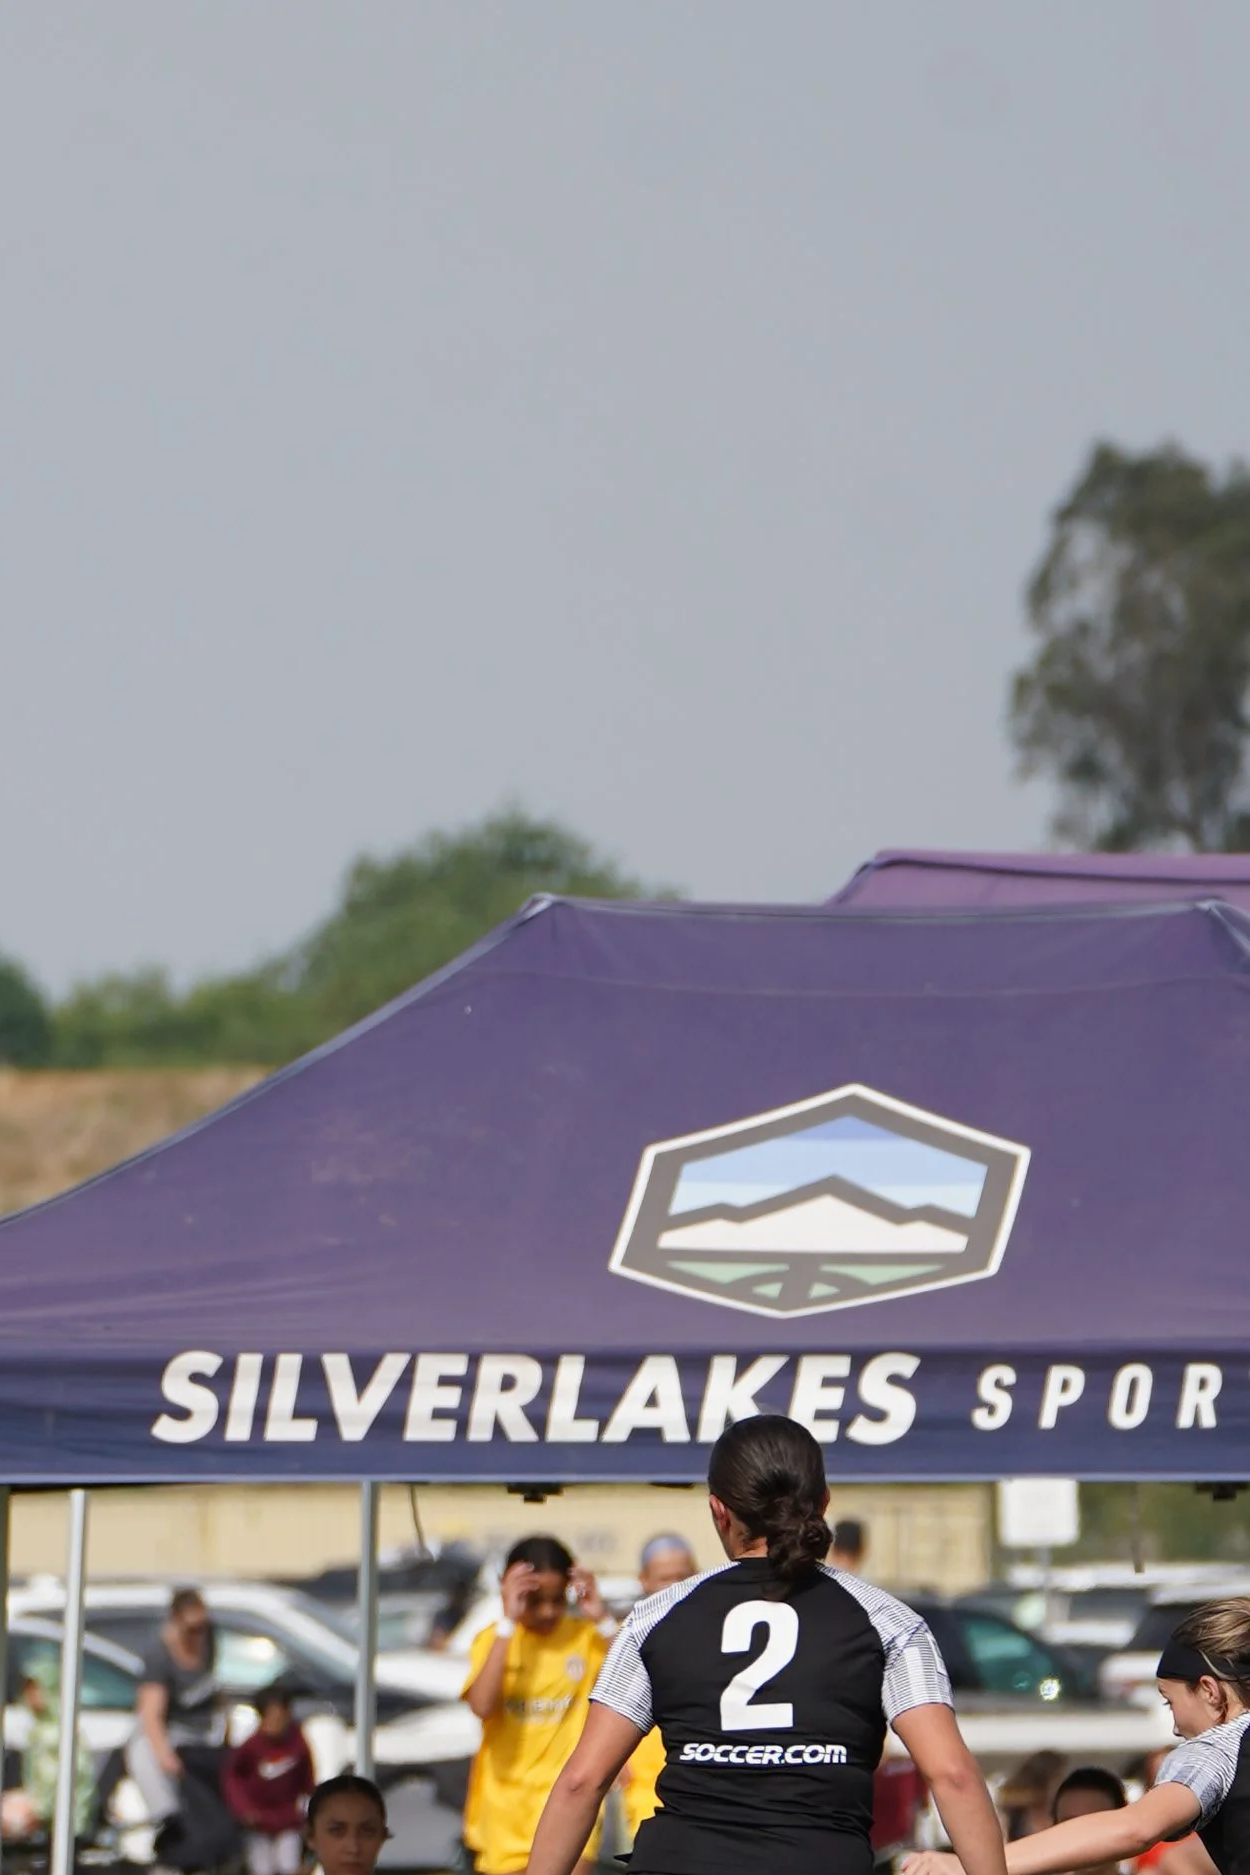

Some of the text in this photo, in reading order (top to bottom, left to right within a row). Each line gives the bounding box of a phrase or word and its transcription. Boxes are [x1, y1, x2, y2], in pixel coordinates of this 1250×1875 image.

[150, 1350, 1250, 1446] SILVERLAKES SPOR
[720, 1599, 799, 1731] 2
[679, 1742, 848, 1765] SOCCER.COM
